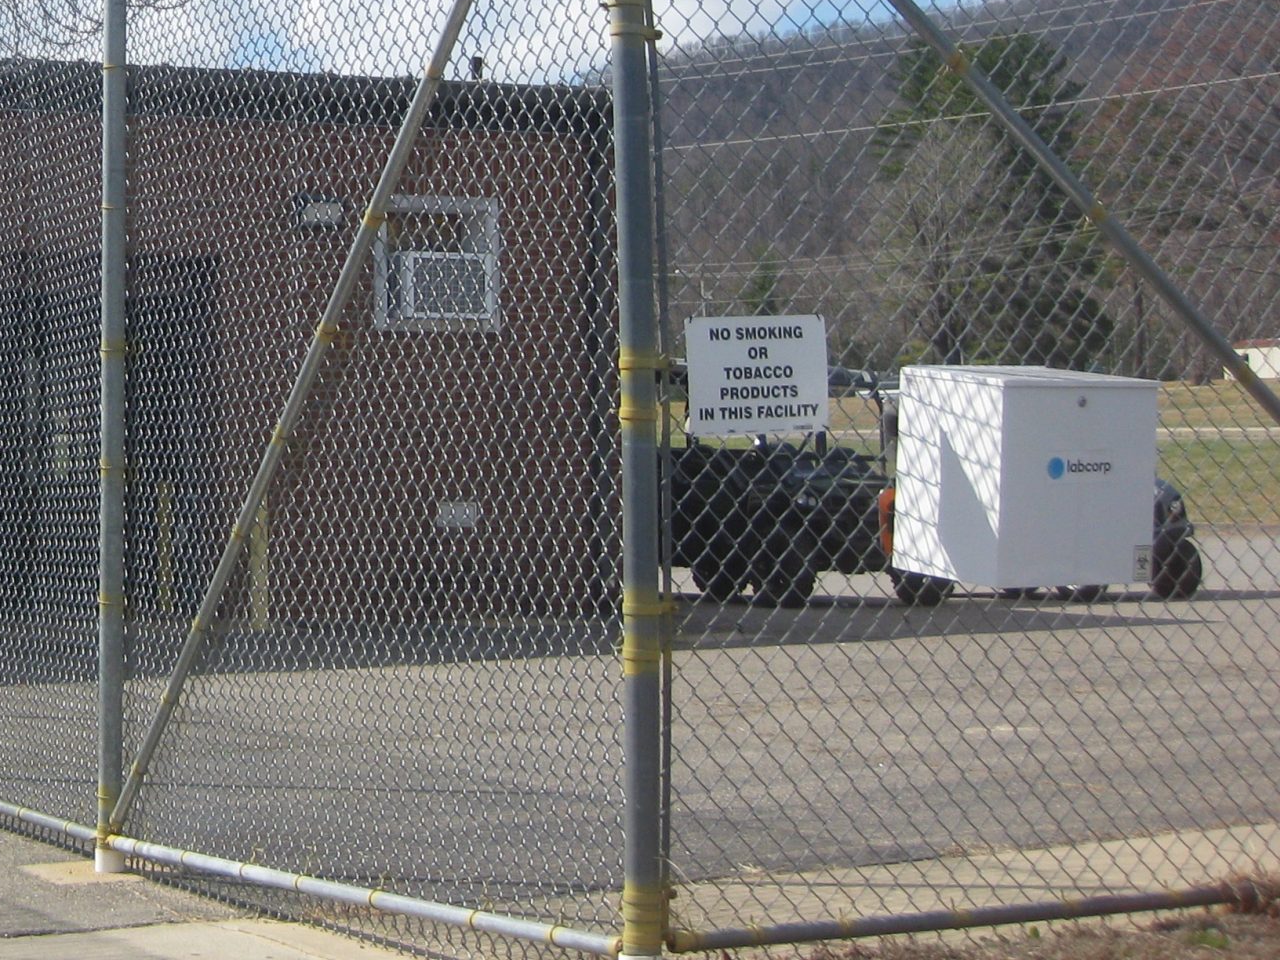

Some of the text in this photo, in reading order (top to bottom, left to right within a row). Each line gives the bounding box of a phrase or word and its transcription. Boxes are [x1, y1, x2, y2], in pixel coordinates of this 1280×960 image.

[709, 326, 803, 340] NO SMOKING
[748, 347, 768, 359] OR
[724, 365, 793, 380] TOBACCO
[720, 385, 798, 400] PRODUCTS
[699, 404, 819, 420] IN THIS FACILITY
[1066, 459, 1111, 475] labcorp
